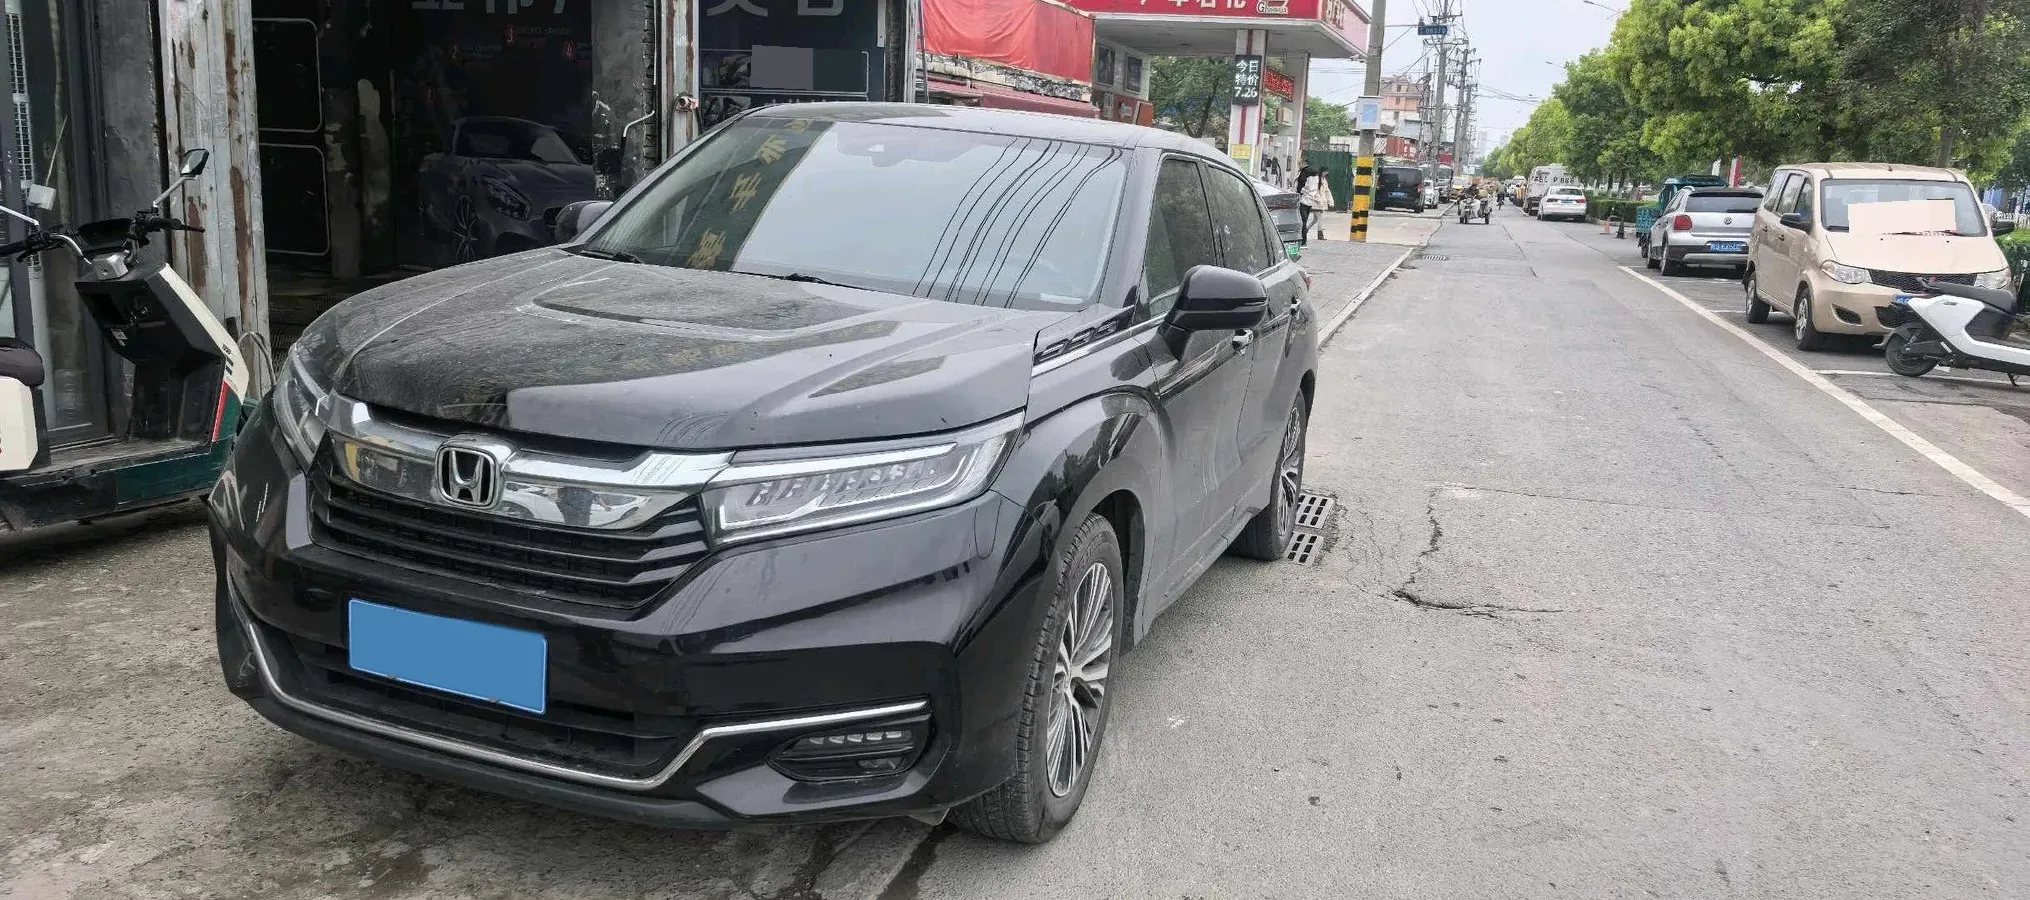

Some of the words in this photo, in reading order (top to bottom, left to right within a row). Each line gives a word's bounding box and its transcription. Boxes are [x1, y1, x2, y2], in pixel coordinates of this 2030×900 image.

[1236, 60, 1258, 73] 今日
[1235, 73, 1259, 86] 特价
[1234, 87, 1258, 98] 7.26
